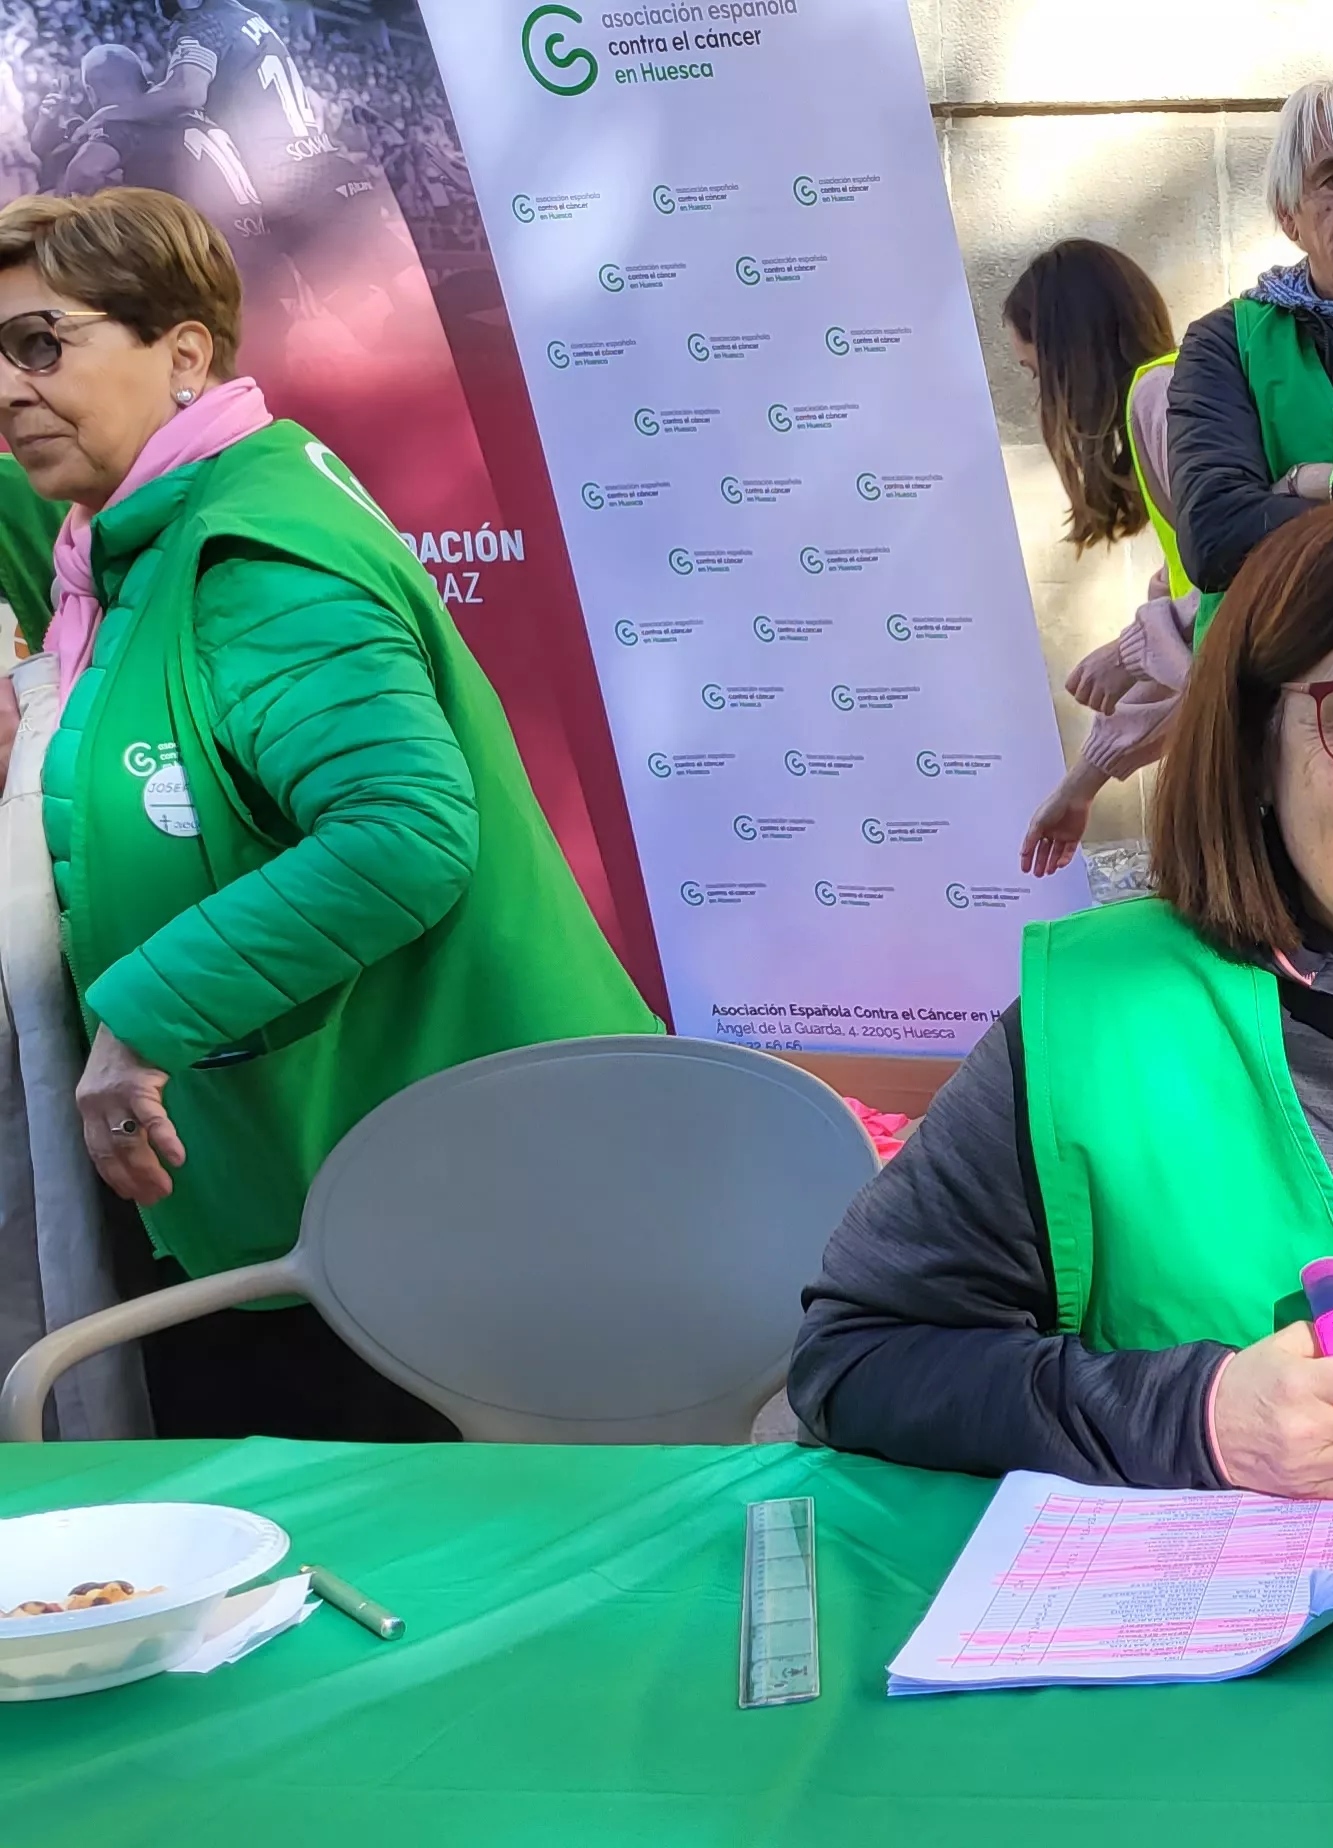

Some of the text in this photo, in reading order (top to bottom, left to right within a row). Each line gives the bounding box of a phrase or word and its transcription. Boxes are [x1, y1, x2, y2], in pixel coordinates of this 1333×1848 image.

[602, 3, 704, 28] asociación
[608, 28, 761, 56] contra el cáncer
[615, 61, 714, 84] en Huesca
[712, 1003, 787, 1017] Asociación
[790, 1004, 851, 1019] Española
[854, 1006, 899, 1020] Contra
[902, 1008, 914, 1020] el
[917, 1008, 967, 1021] Cáncer
[971, 1012, 988, 1022] en
[717, 1019, 756, 1036] Ángel
[759, 1023, 776, 1034] de
[779, 1022, 791, 1035] la
[862, 1026, 901, 1040] 22005
[903, 1028, 955, 1039] Huesca
